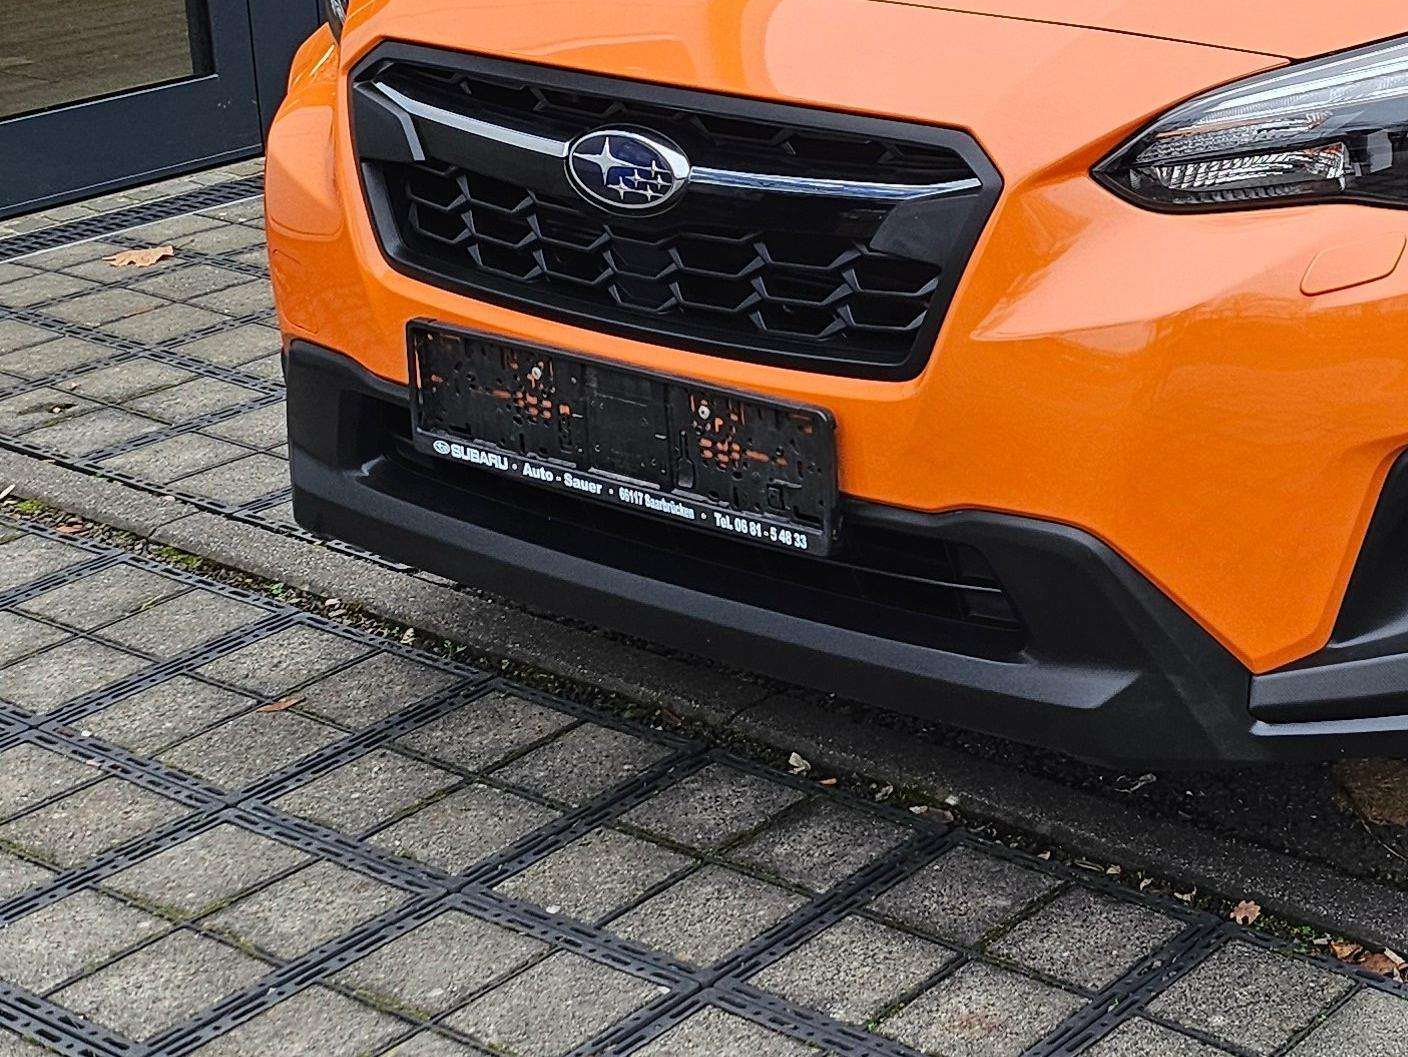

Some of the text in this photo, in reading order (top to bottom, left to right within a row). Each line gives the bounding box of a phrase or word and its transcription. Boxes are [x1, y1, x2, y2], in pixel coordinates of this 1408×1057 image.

[450, 443, 509, 471] SUBARU
[522, 462, 554, 482] Auto
[563, 472, 603, 494] Sauer
[793, 532, 808, 550] 33
